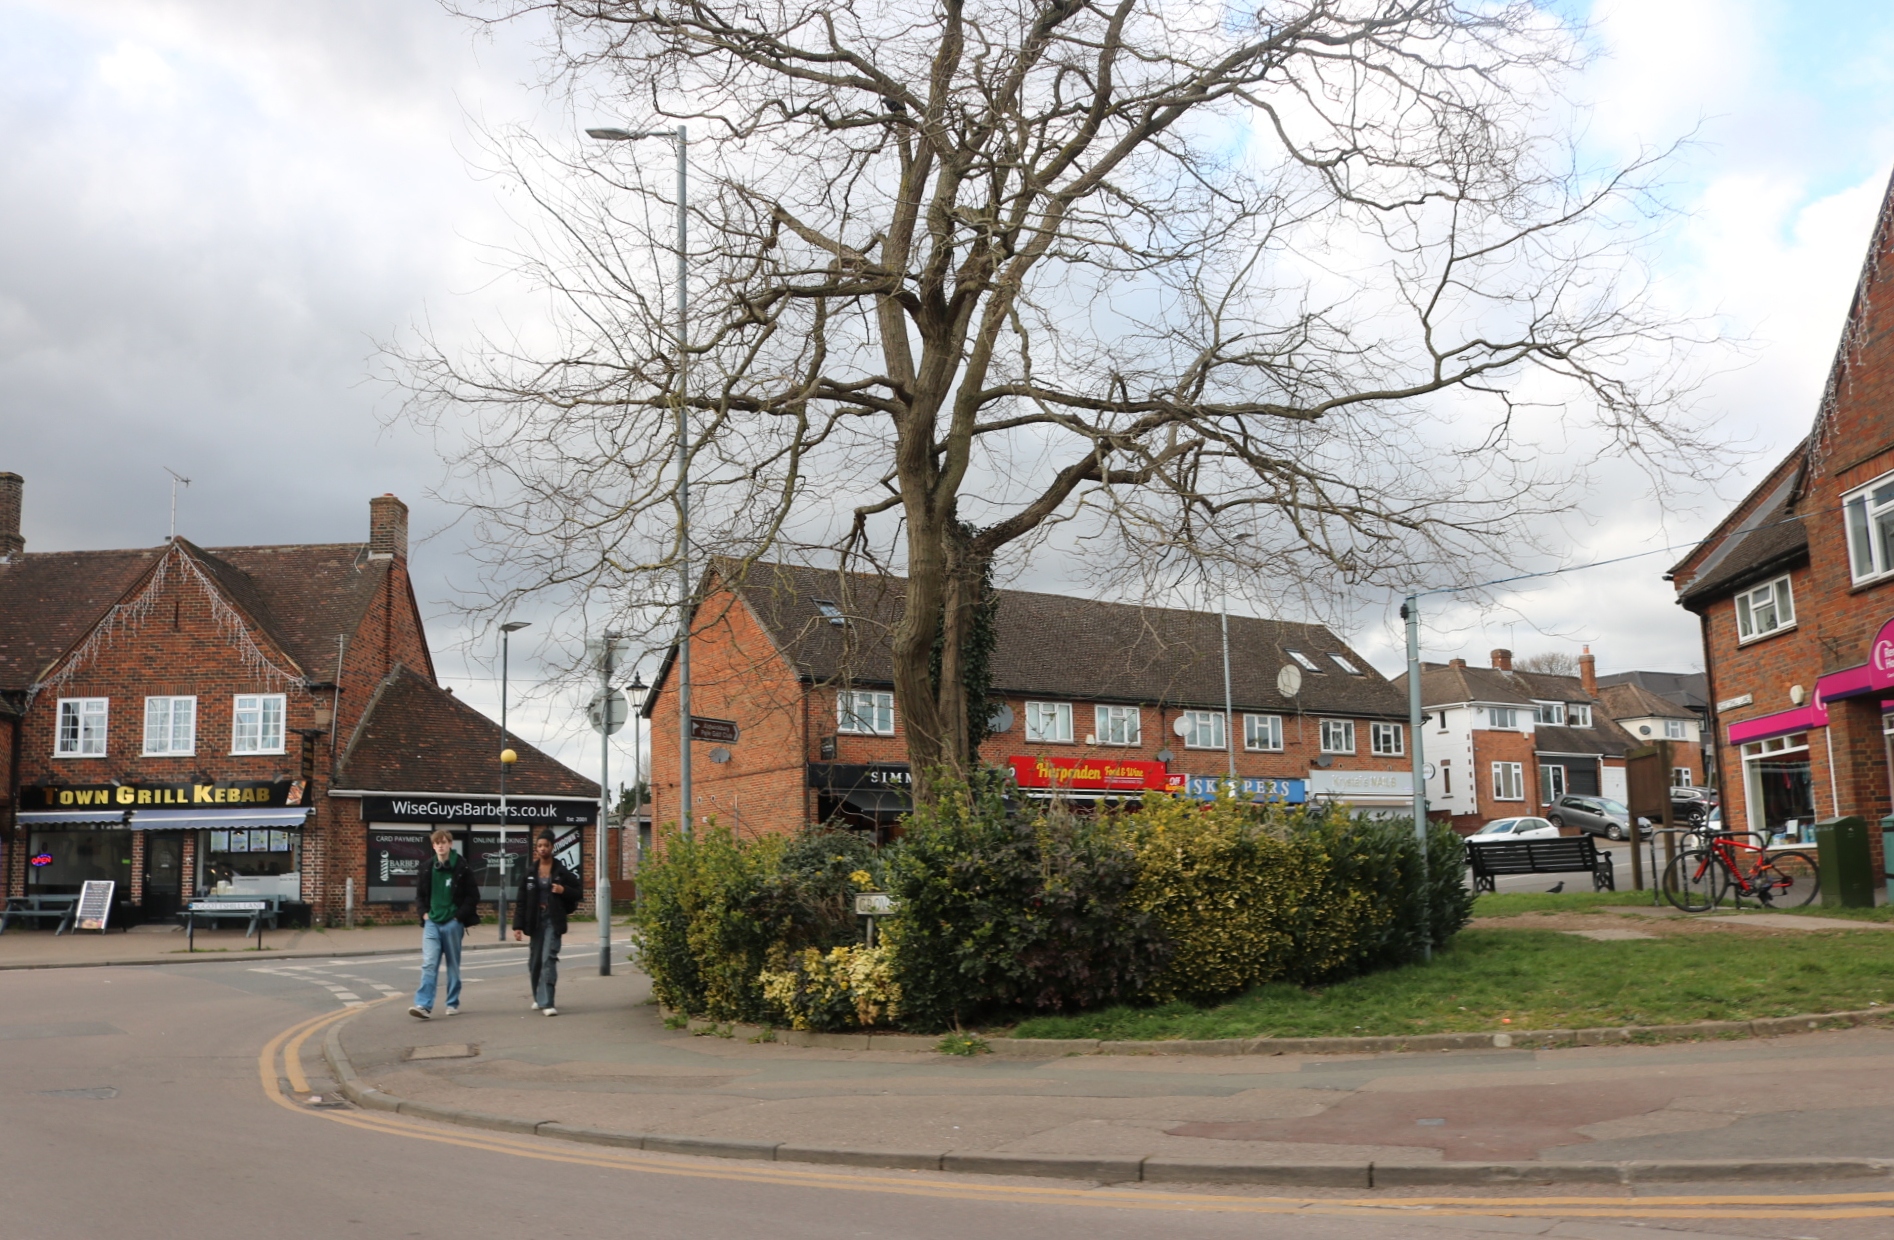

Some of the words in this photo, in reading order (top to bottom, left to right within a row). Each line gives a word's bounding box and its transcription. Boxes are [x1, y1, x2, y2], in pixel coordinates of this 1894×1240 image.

[1036, 763, 1102, 783] Harpenden
[1126, 767, 1144, 777] Wine
[1194, 779, 1290, 796] SKPERS
[1370, 776, 1397, 789] NAILS
[42, 786, 109, 805] TOWN
[116, 785, 189, 804] GRILL
[193, 784, 271, 803] KEBAB
[392, 800, 558, 819] WiseGuysBarbers.co.uk
[375, 835, 393, 843] CARD
[394, 835, 424, 843] PAYMENT
[473, 836, 496, 844] ONLINE
[31, 856, 53, 865] OPEN
[859, 898, 891, 912] GROV
